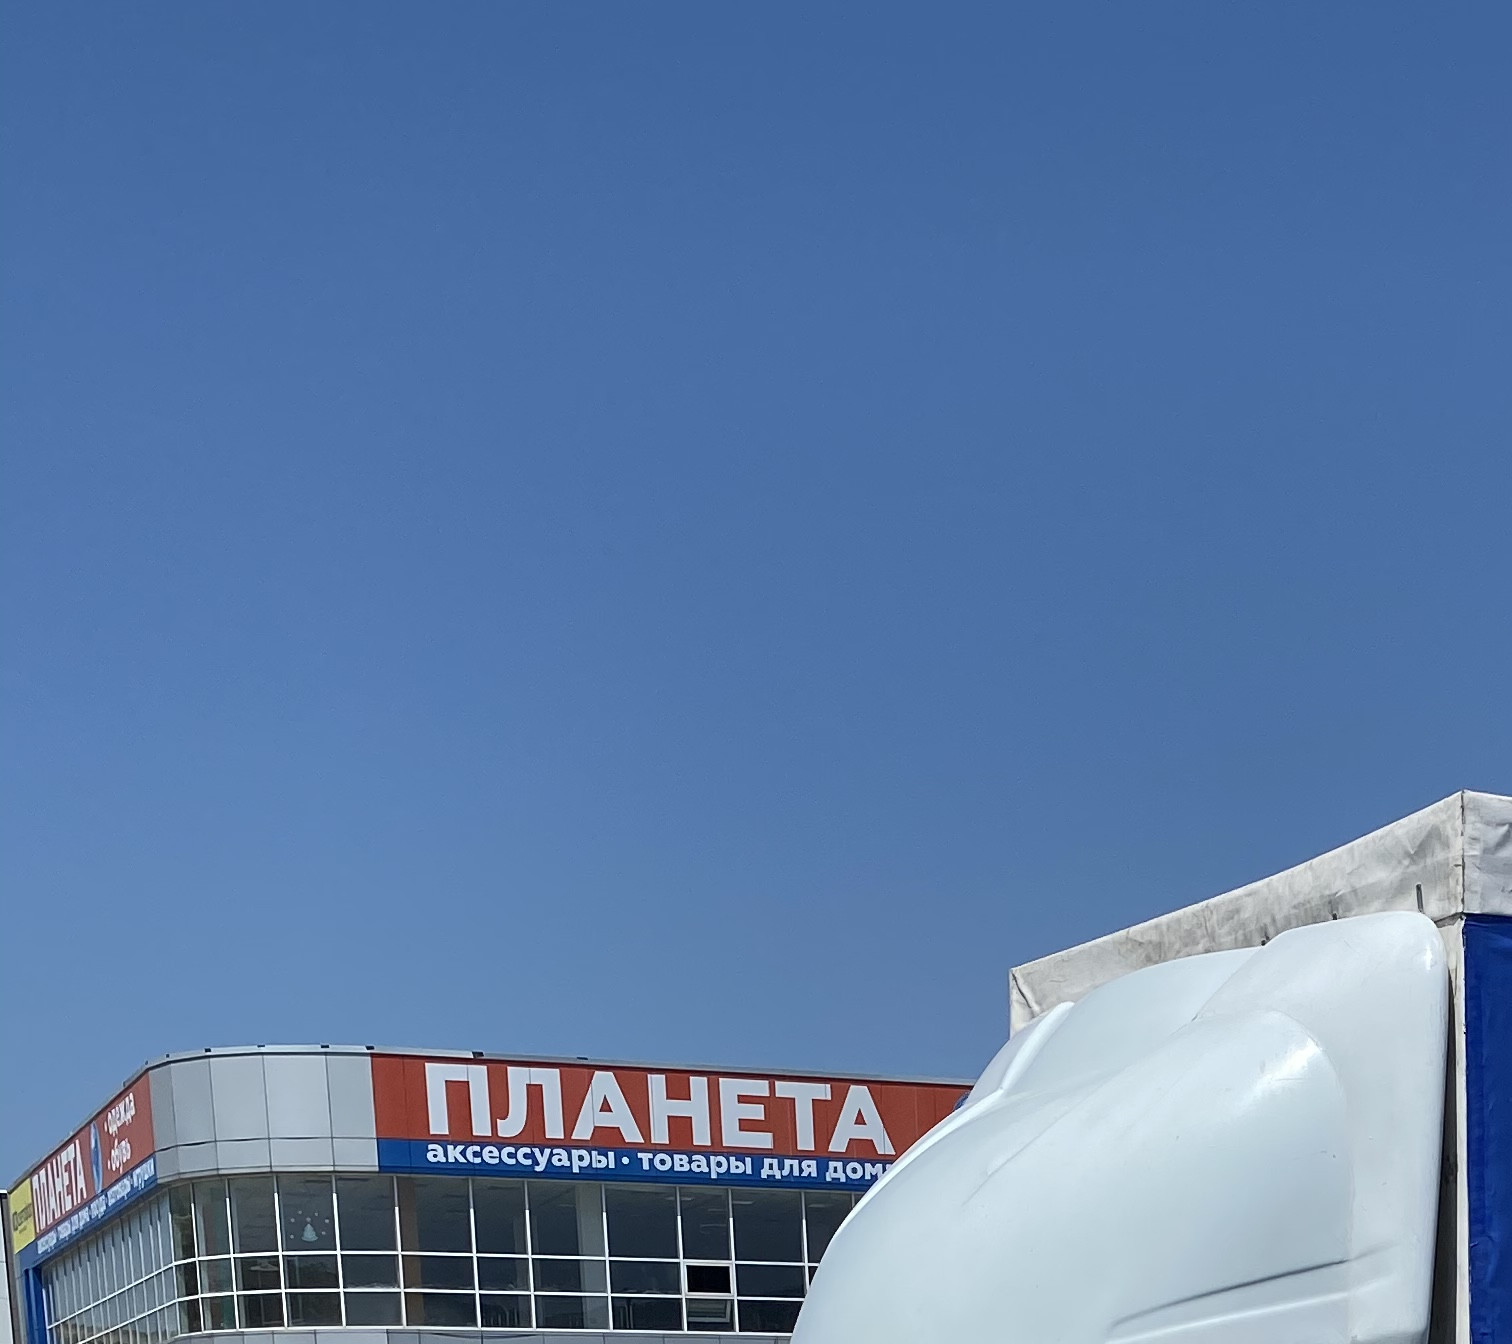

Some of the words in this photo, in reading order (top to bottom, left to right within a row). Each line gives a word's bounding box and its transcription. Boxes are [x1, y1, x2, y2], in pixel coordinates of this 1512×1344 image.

[425, 1062, 896, 1156] ПЛАНЕТА
[31, 1139, 87, 1233] ПЛАНЕТА
[426, 1143, 615, 1174] аксессуары
[637, 1152, 752, 1179] товары
[760, 1157, 818, 1180] для
